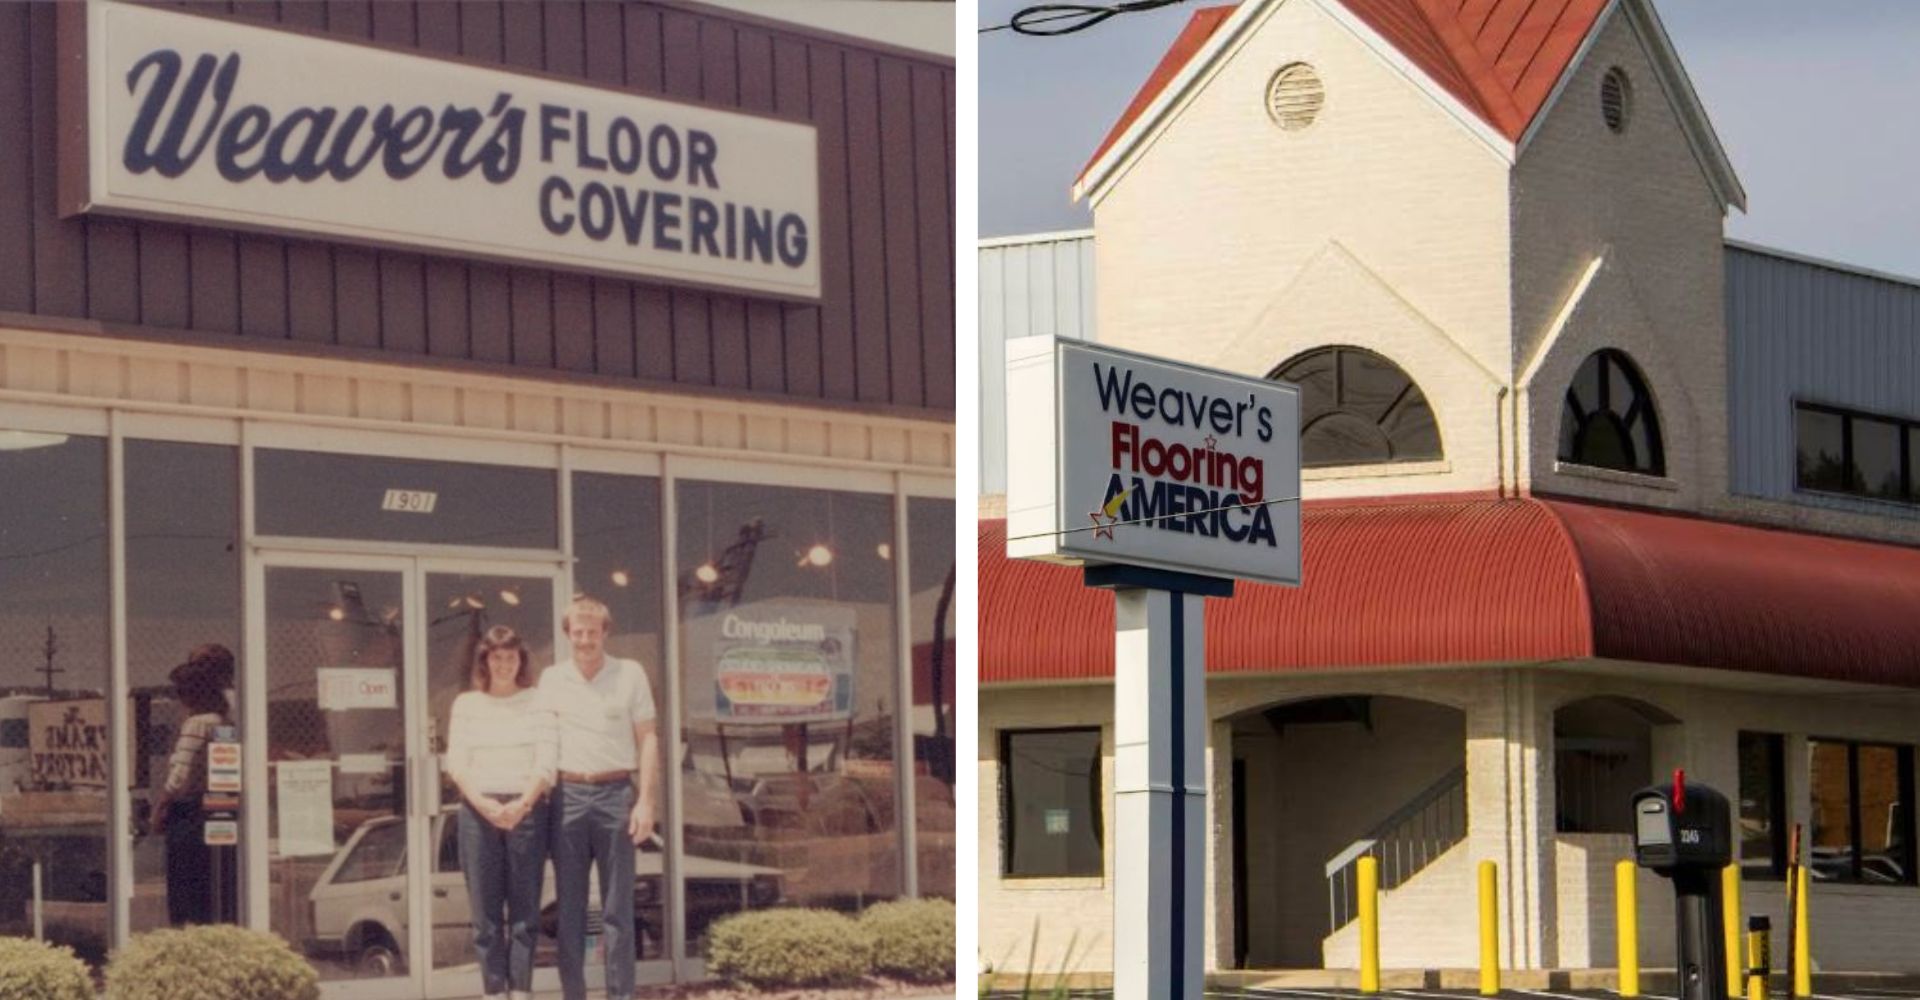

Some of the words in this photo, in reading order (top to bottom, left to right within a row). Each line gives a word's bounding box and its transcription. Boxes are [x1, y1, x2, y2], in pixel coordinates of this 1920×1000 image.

[123, 49, 526, 185] Weaver's
[540, 104, 720, 190] FLOOR
[539, 176, 809, 269] COVERING
[1093, 362, 1273, 442] Weaver's
[387, 491, 432, 511] 1901
[1111, 421, 1264, 507] Flooring
[1101, 473, 1278, 548] AMERICA
[722, 613, 826, 645] Congoleum
[358, 680, 389, 697] Open
